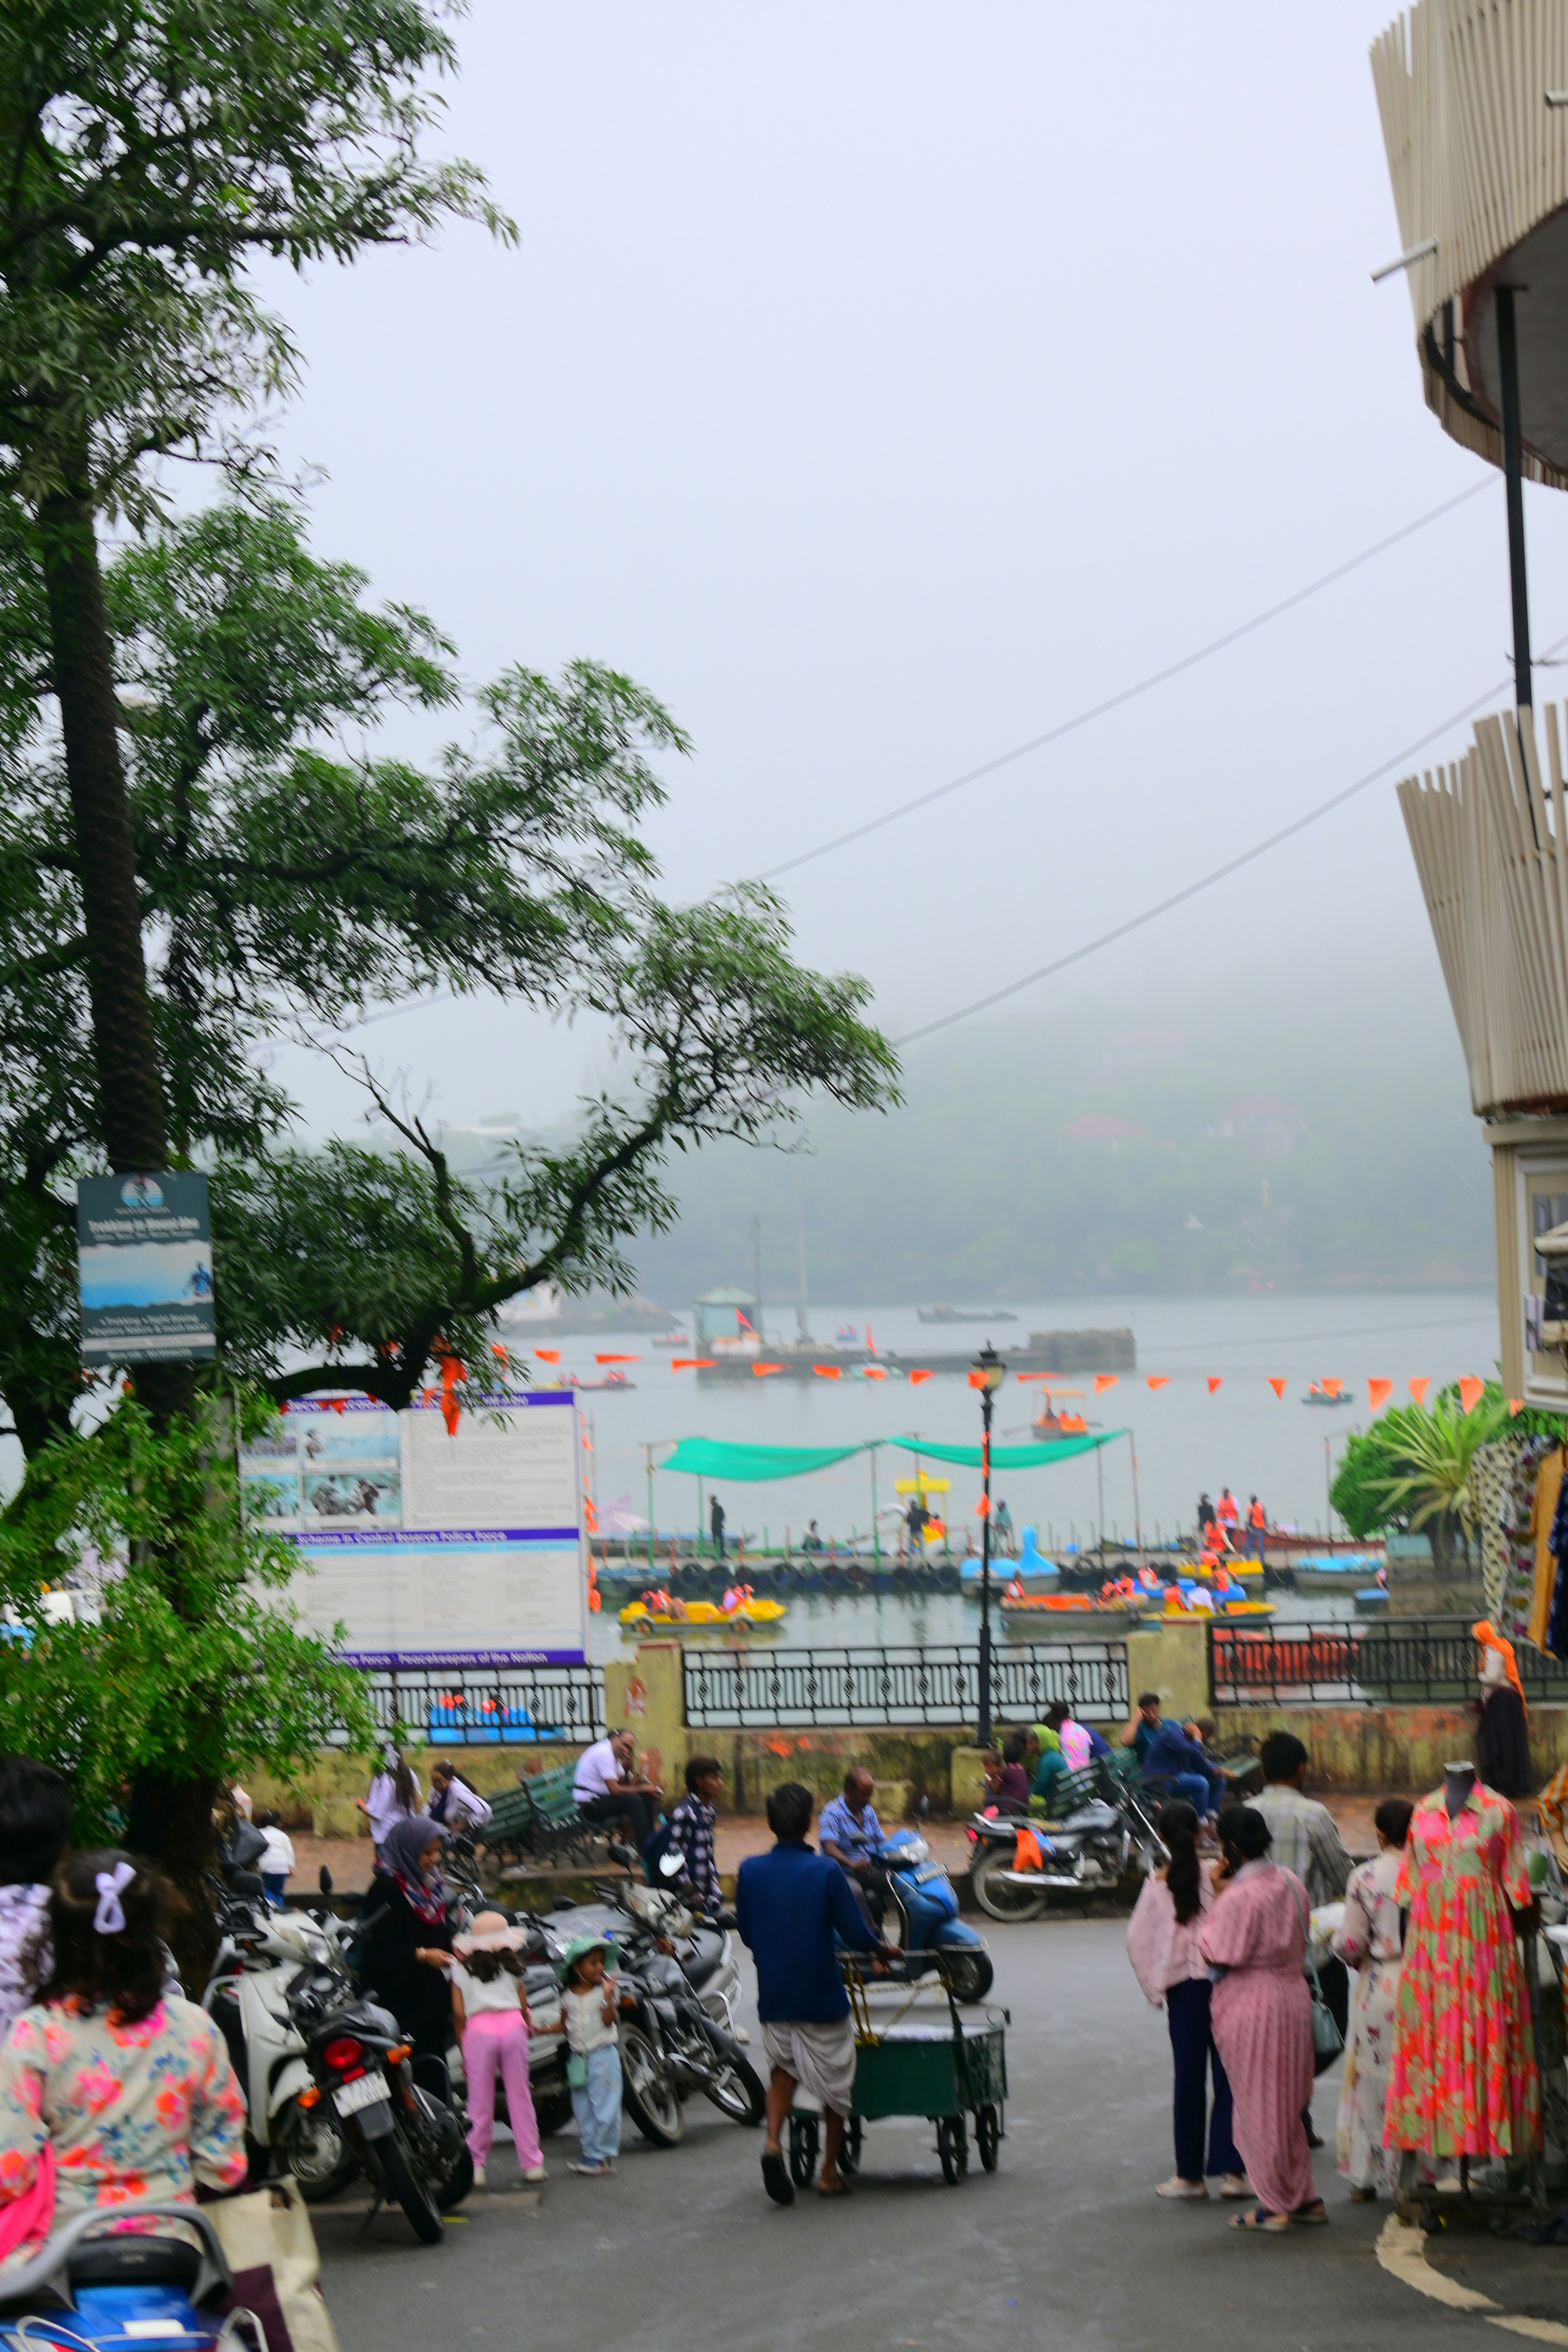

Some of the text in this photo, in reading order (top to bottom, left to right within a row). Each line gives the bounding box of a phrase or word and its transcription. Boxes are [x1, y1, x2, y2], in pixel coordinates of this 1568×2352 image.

[359, 1653, 392, 1665] Force
[397, 1652, 477, 1666] Peacekeepers
[476, 1651, 490, 1663] of
[490, 1651, 510, 1663] the
[510, 1650, 548, 1663] Nation
